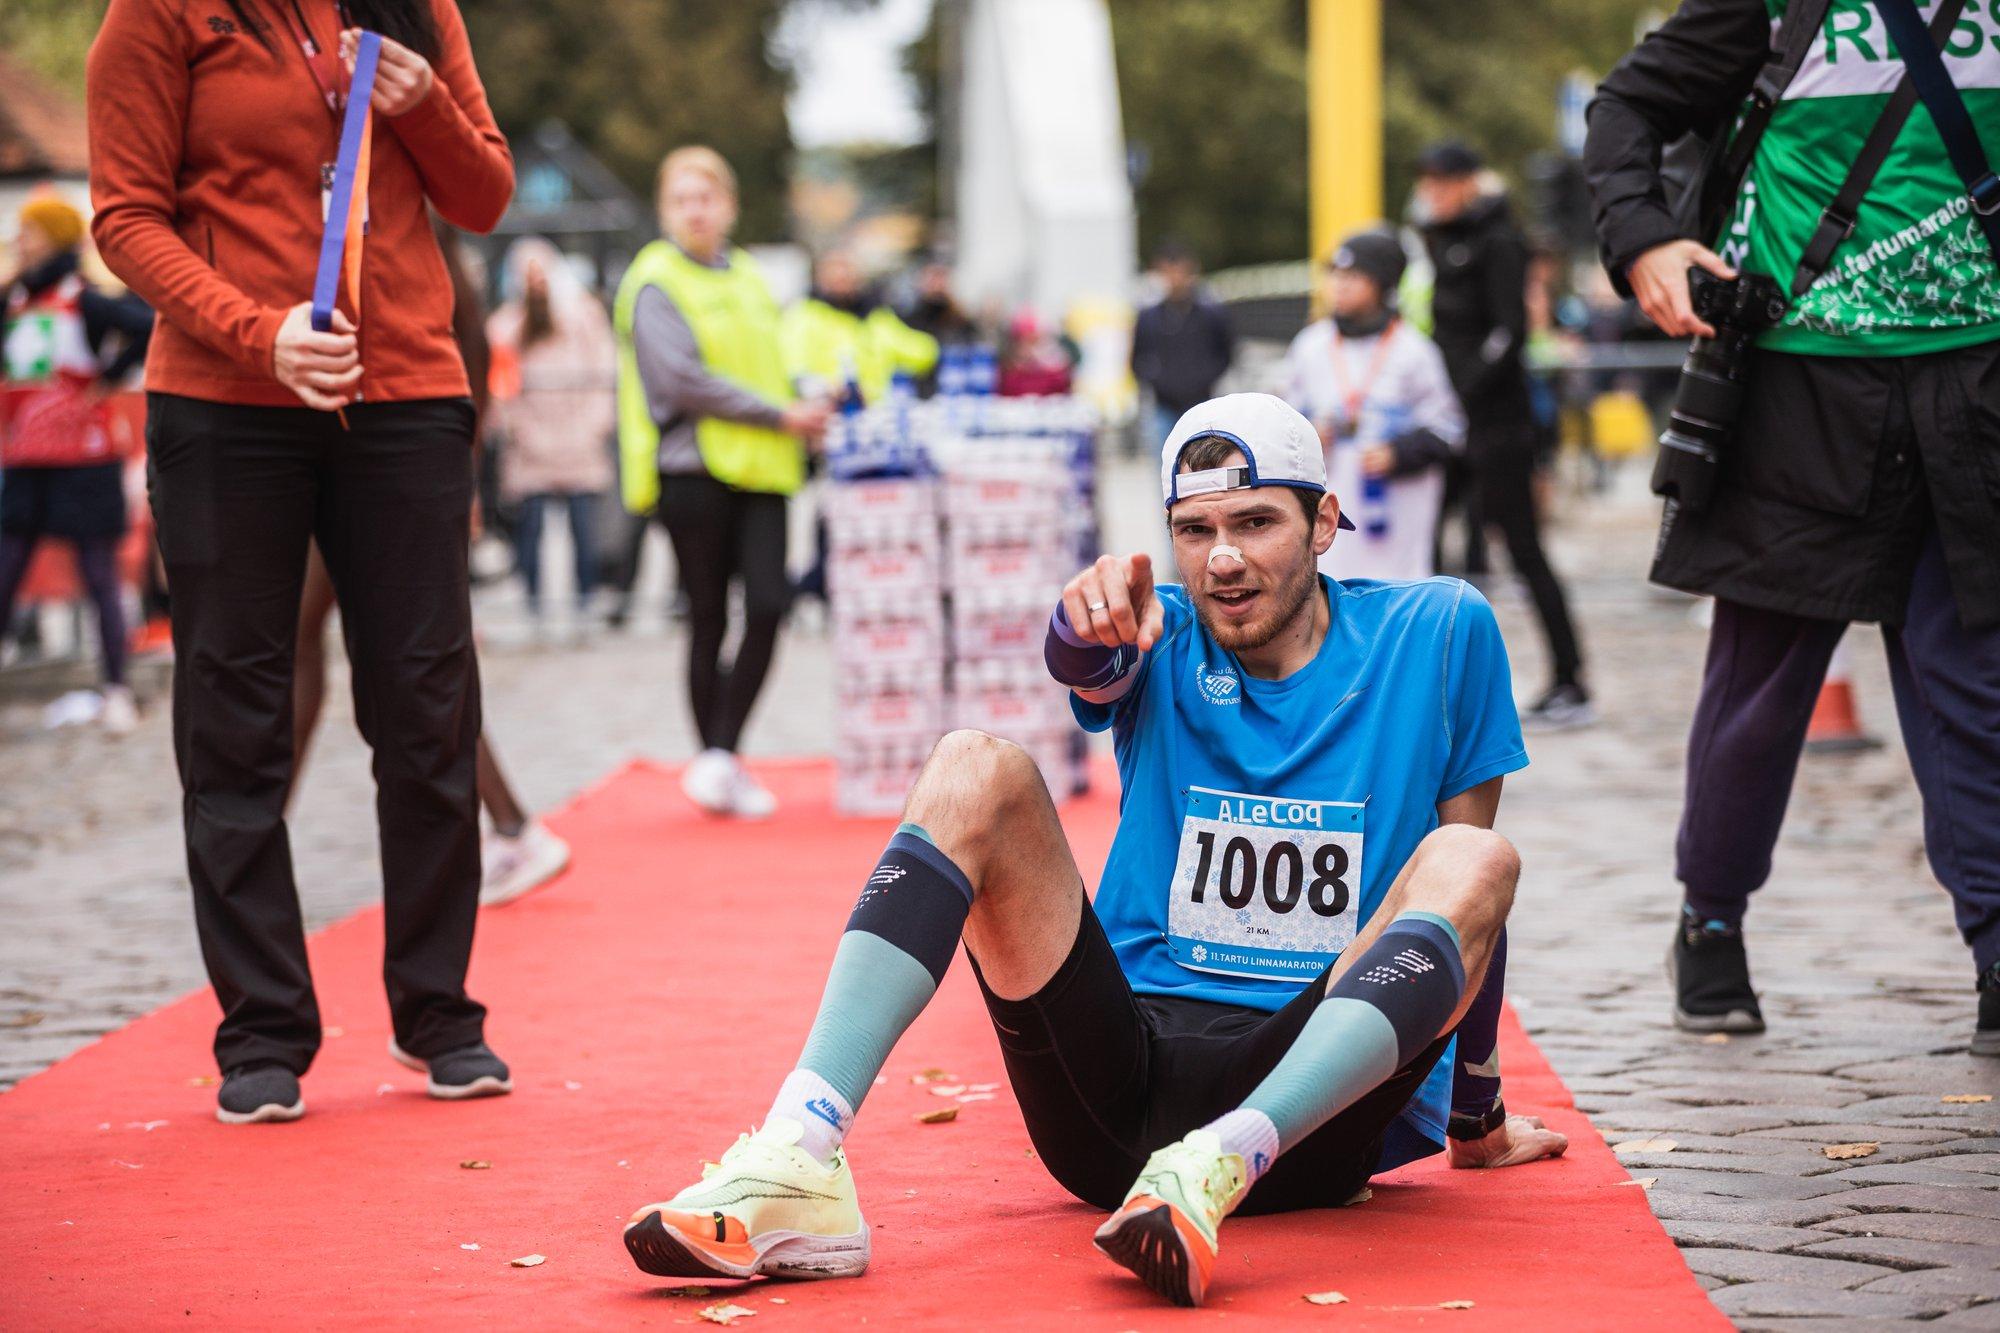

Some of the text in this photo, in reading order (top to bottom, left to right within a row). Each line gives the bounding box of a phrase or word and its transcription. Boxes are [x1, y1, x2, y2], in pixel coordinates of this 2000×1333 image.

[1191, 831, 1350, 918] 1008
[1246, 926, 1270, 935] 21 KM
[1250, 957, 1324, 970] LINNAMARATON
